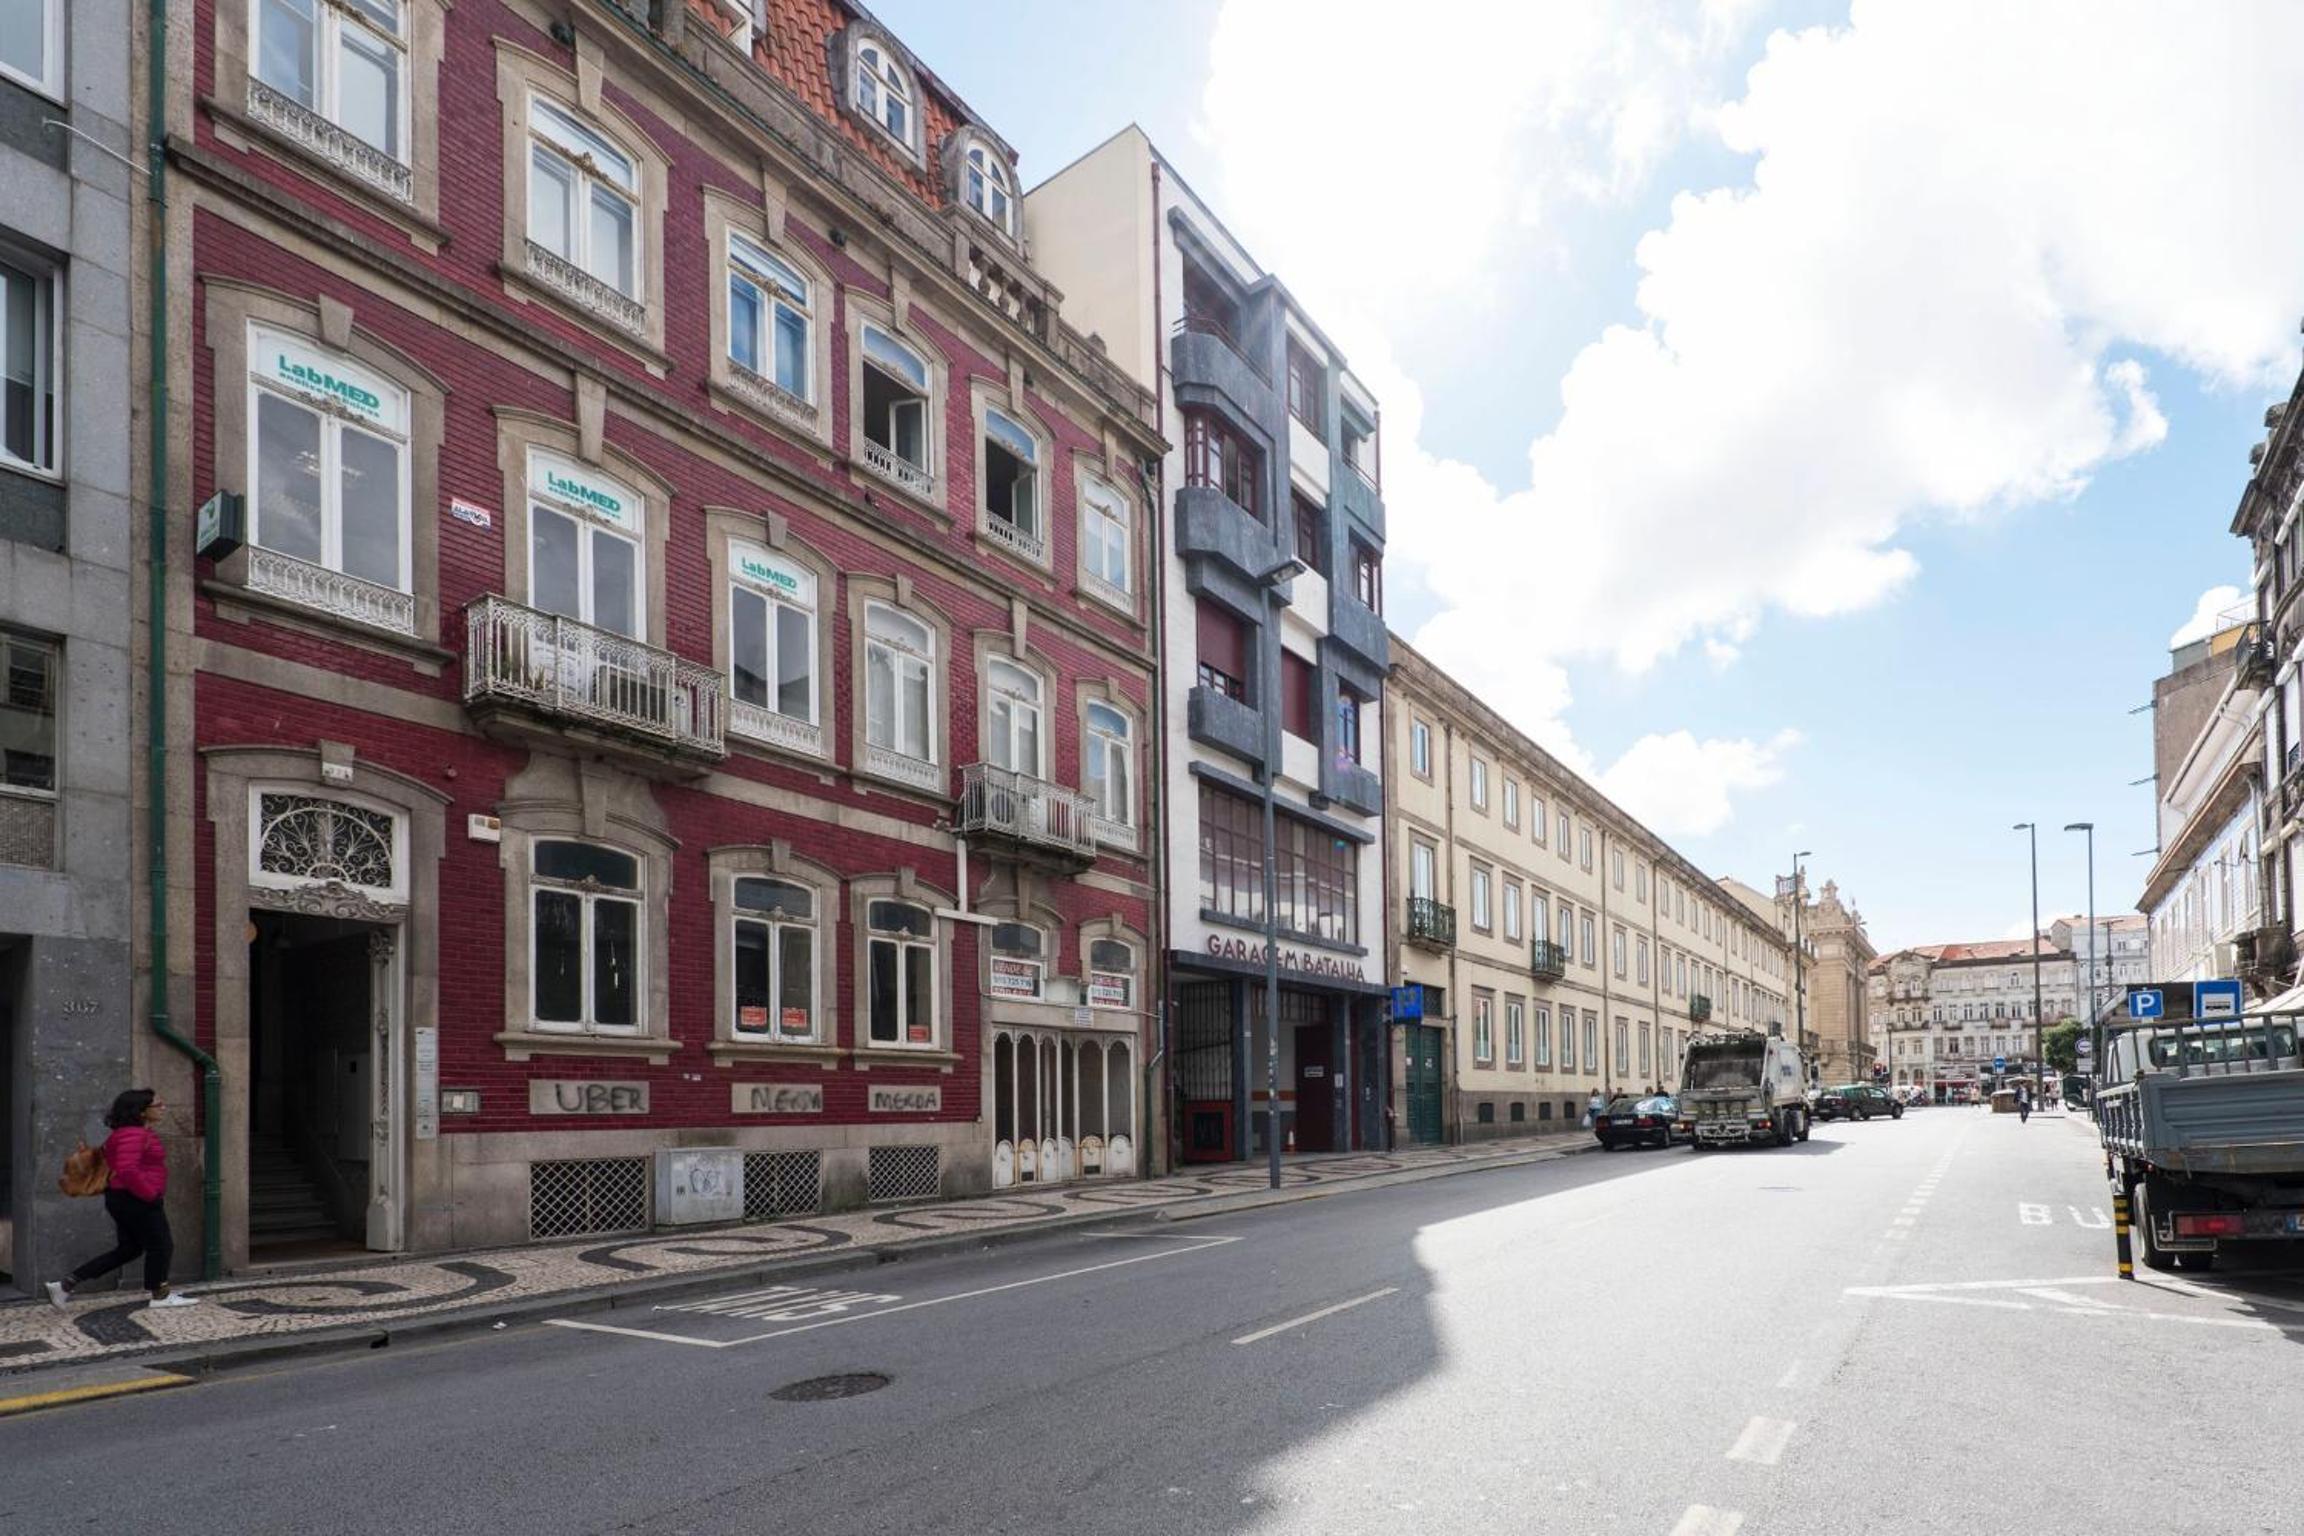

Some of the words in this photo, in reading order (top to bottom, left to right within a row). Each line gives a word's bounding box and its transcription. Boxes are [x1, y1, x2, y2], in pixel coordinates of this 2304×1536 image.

[279, 354, 380, 408] LabMED
[548, 471, 621, 513] LabMED
[742, 557, 798, 589] LabMED
[1303, 952, 1365, 982] BATALHA
[2137, 994, 2155, 1015] P
[555, 1083, 645, 1112] UBER
[2019, 1201, 2113, 1229] BU
